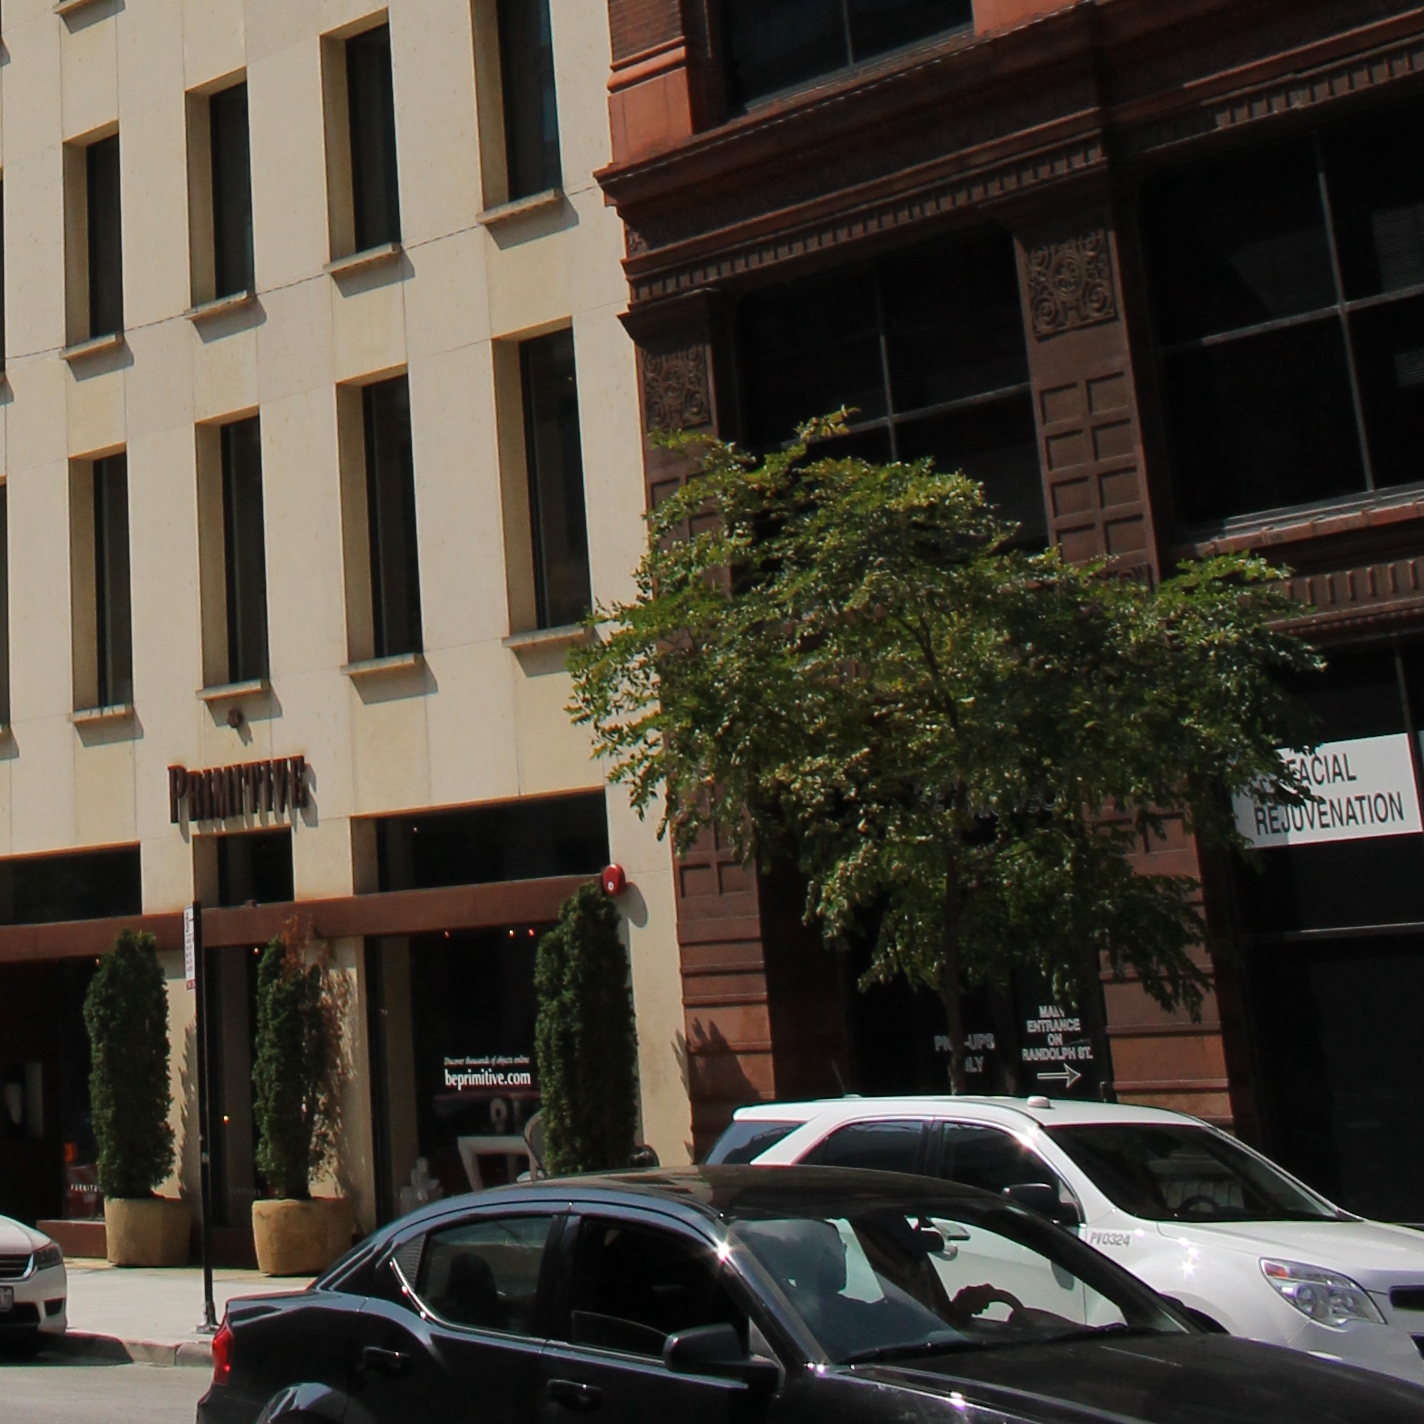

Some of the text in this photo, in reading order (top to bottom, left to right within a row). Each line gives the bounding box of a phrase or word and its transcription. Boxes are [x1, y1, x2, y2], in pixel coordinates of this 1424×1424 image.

[168, 755, 311, 824] PRIMITIVE
[1253, 791, 1405, 836] REJUVENATION
[1026, 1018, 1081, 1032] ENTRANCE
[1047, 1033, 1063, 1046] ON
[1022, 1046, 1093, 1061] RANDOLPH ST.
[444, 1068, 532, 1091] beprimitive.com
[70, 1183, 100, 1192] FURNITU
